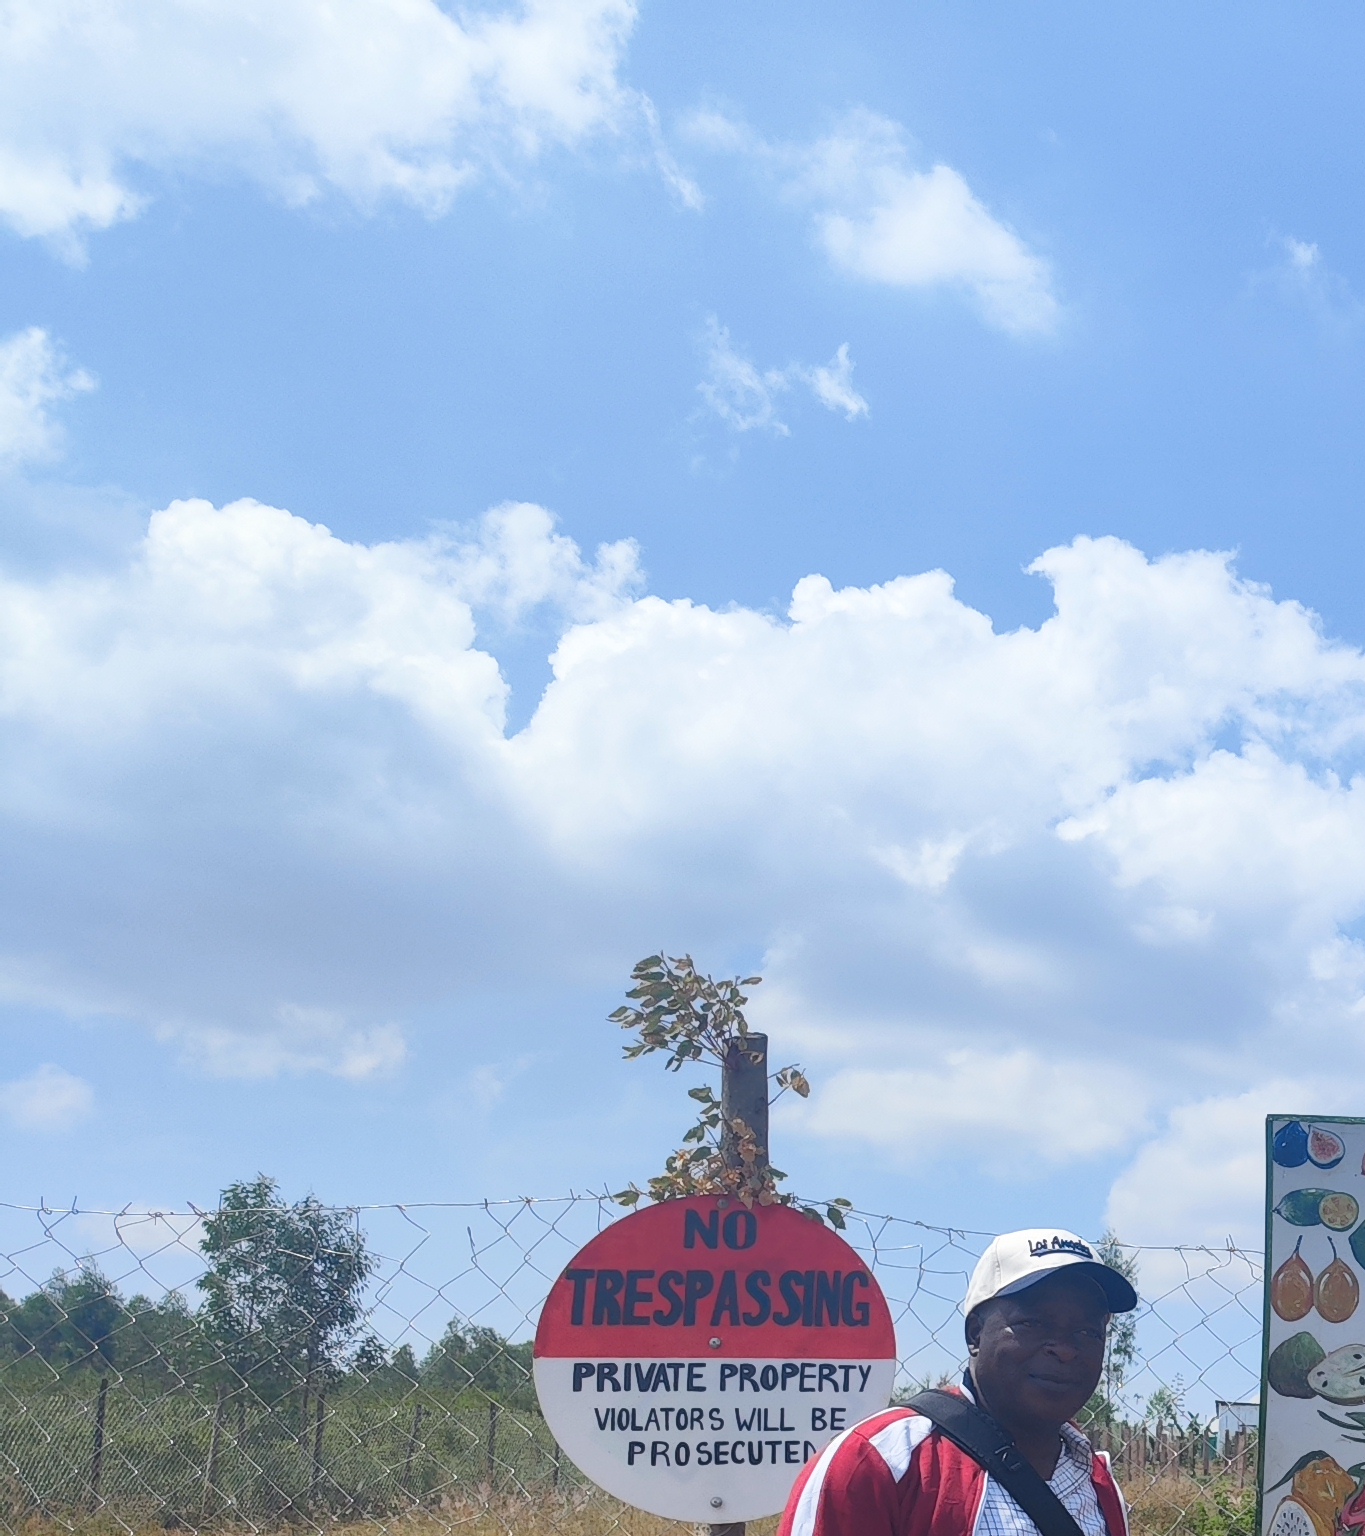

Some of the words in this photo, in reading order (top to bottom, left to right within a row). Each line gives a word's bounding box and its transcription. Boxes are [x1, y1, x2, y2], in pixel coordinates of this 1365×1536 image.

[682, 1208, 757, 1252] NO
[564, 1268, 871, 1328] TRESPASSING
[571, 1361, 707, 1393] PRIVATE
[719, 1362, 872, 1393] PROPERTY
[593, 1406, 725, 1433] VIOLATORS
[734, 1406, 796, 1433] WILL
[810, 1406, 847, 1432] BE
